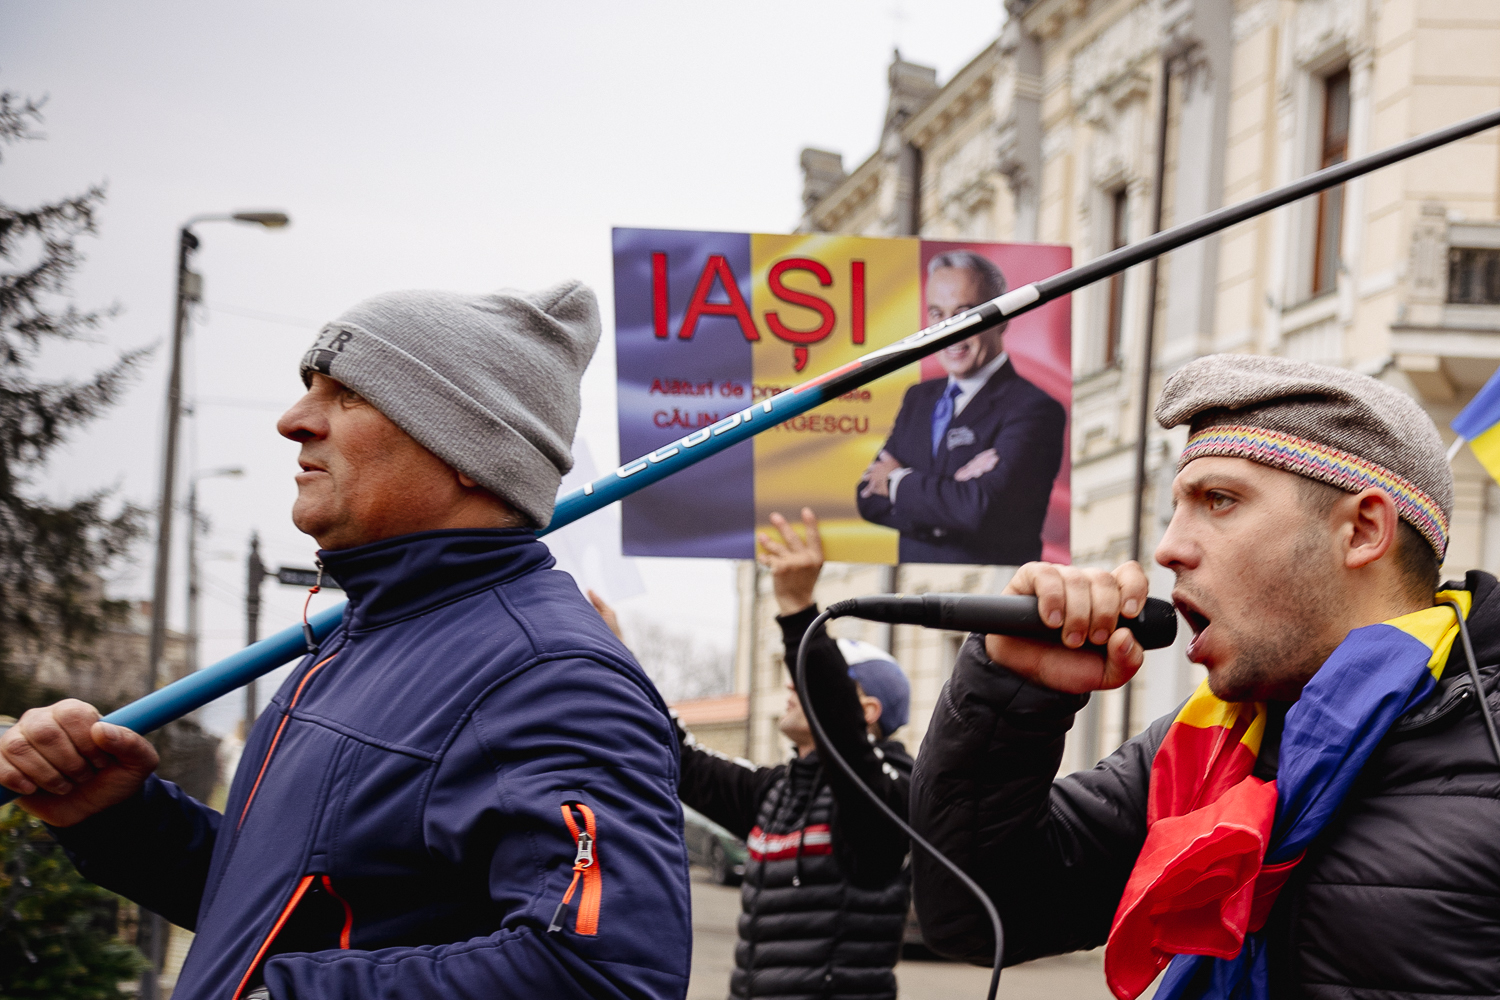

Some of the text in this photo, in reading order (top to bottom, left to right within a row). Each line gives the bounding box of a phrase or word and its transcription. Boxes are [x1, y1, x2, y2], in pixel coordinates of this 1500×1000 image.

[651, 252, 865, 371] IAȘI
[650, 378, 713, 397] Alături
[720, 381, 744, 397] de
[653, 406, 719, 429] CĂLIN
